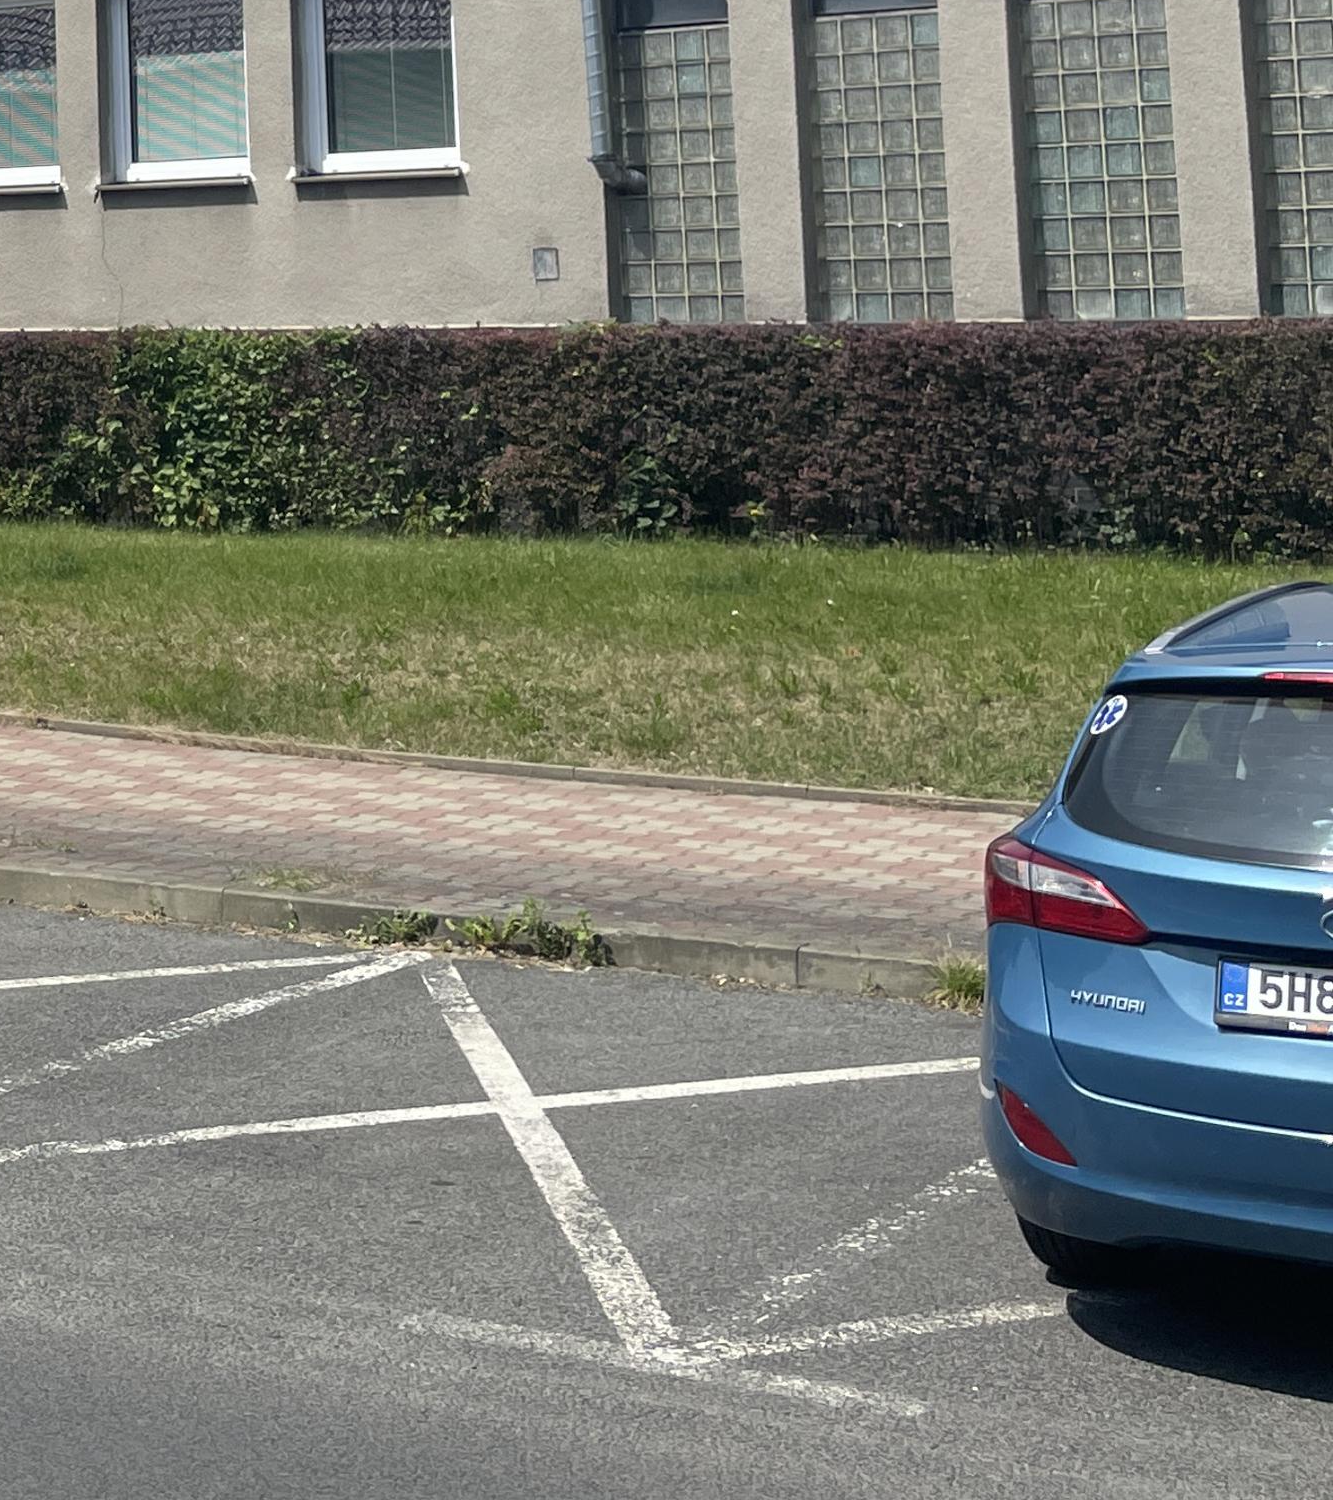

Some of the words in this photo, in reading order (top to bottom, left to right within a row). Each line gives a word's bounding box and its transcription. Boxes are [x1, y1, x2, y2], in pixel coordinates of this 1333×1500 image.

[1070, 989, 1145, 1014] HYUNDAI
[1224, 993, 1245, 1007] CZ
[1259, 970, 1333, 1014] 5H8
